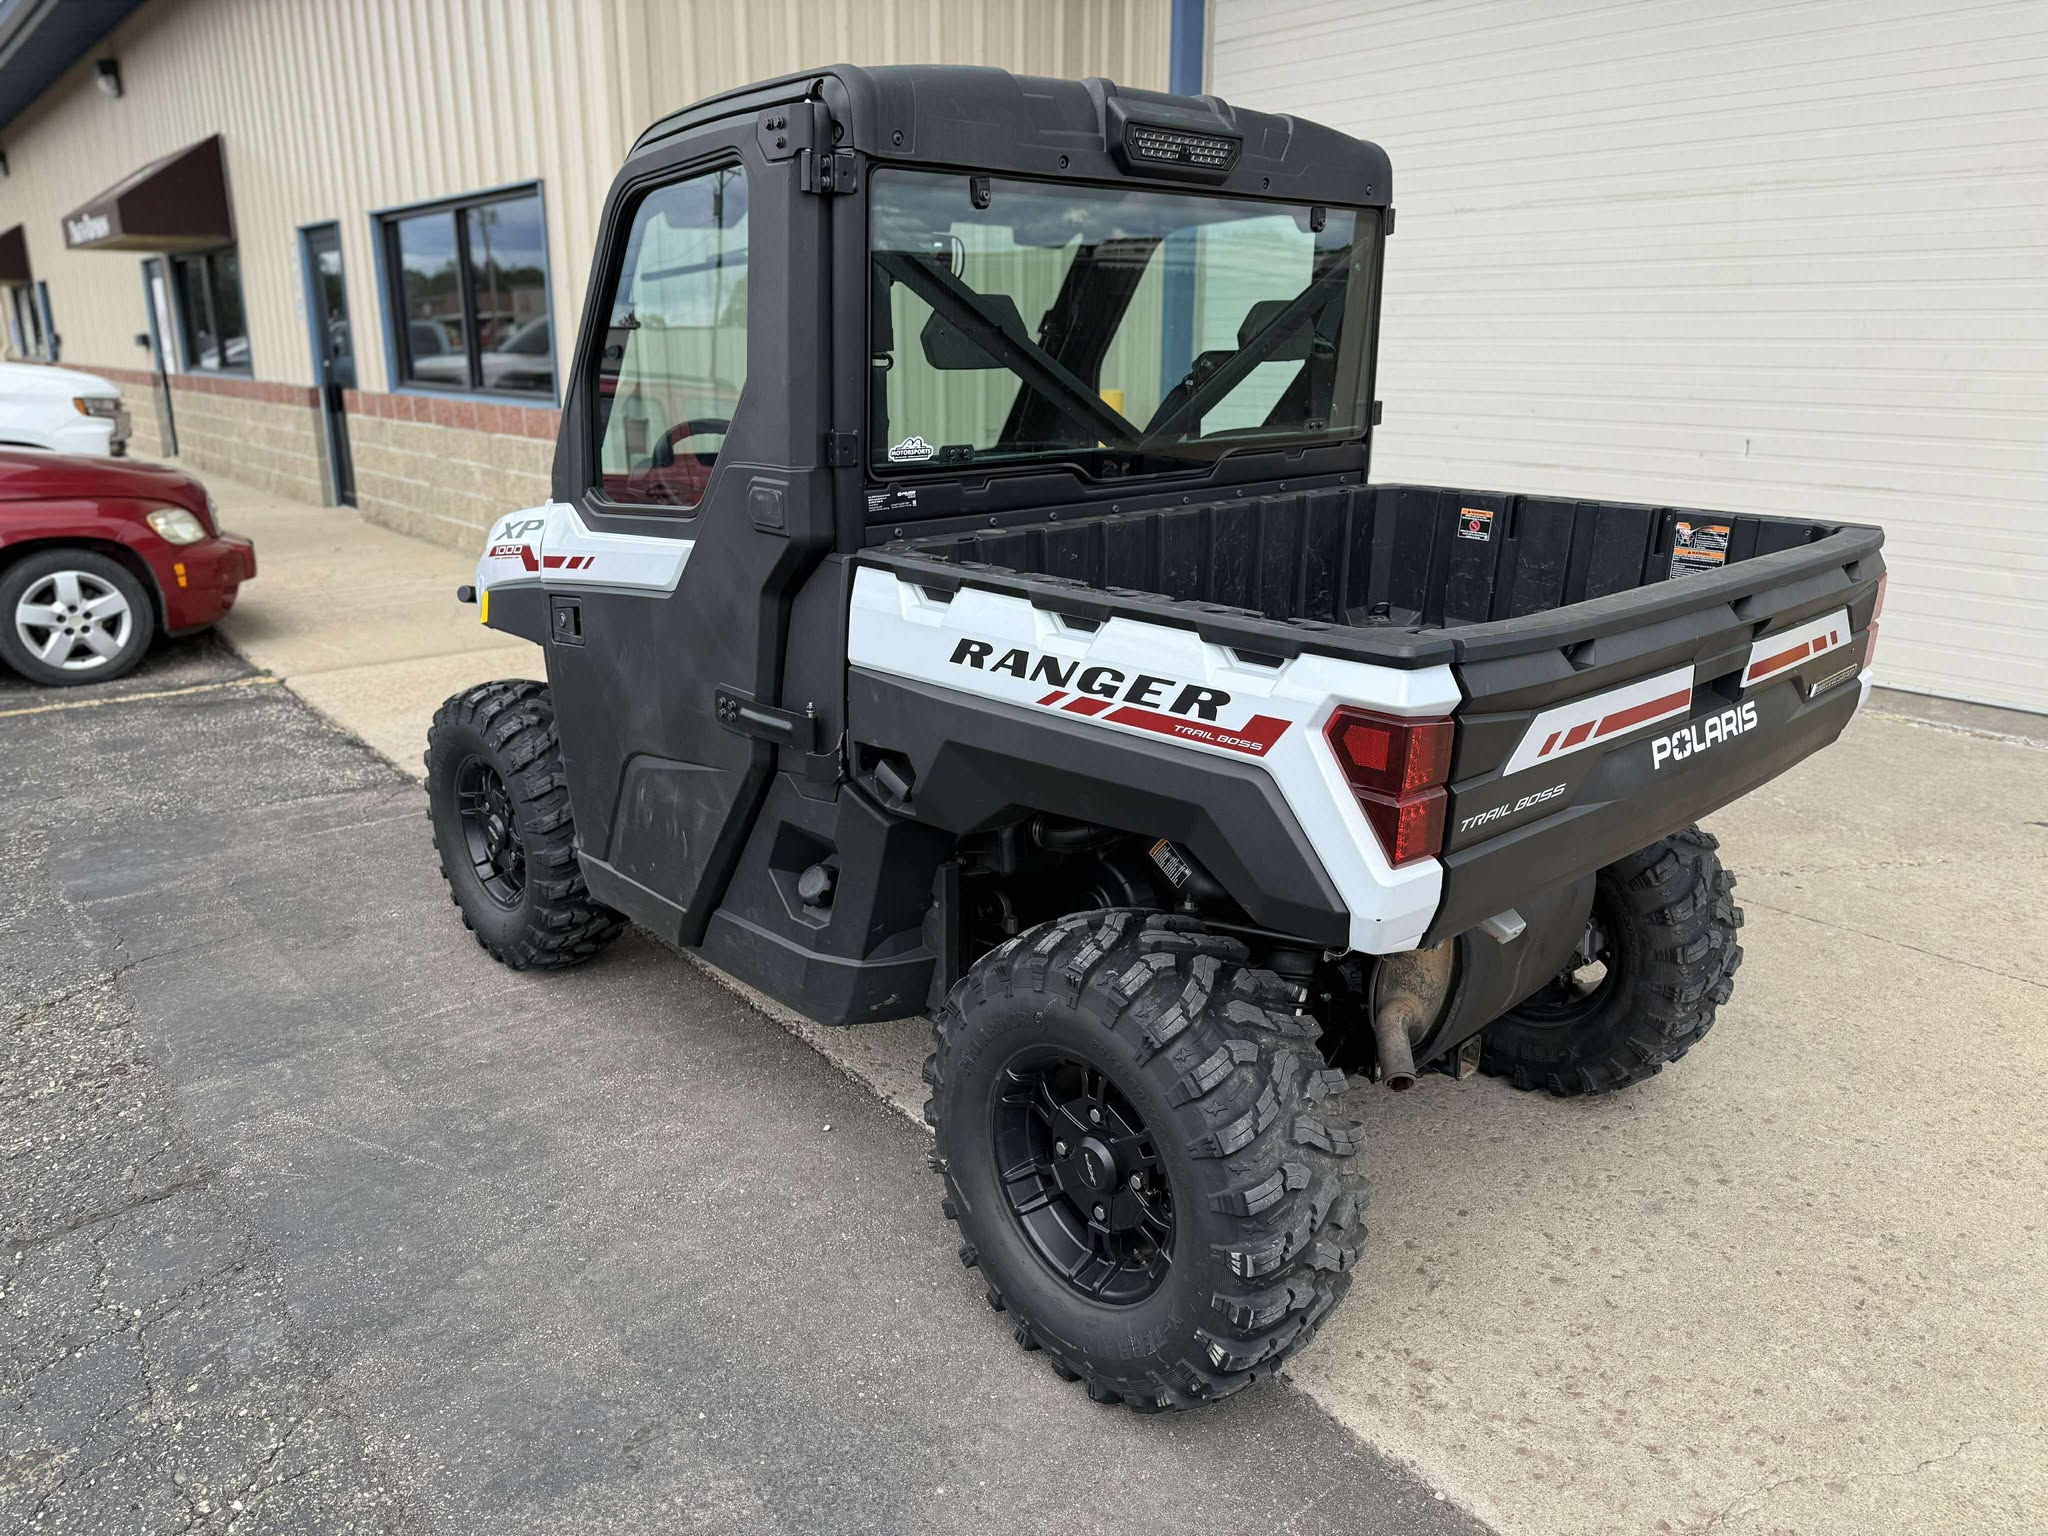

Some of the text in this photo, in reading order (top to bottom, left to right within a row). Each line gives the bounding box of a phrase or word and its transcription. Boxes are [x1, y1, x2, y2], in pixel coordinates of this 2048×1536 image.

[495, 519, 544, 541] XP
[495, 546, 522, 555] 1000
[949, 638, 1231, 722] RANGER
[1174, 724, 1264, 751] TRAIL BOSS
[1651, 700, 1758, 770] POLARIS
[1461, 783, 1567, 833] TRAIL BOSS
